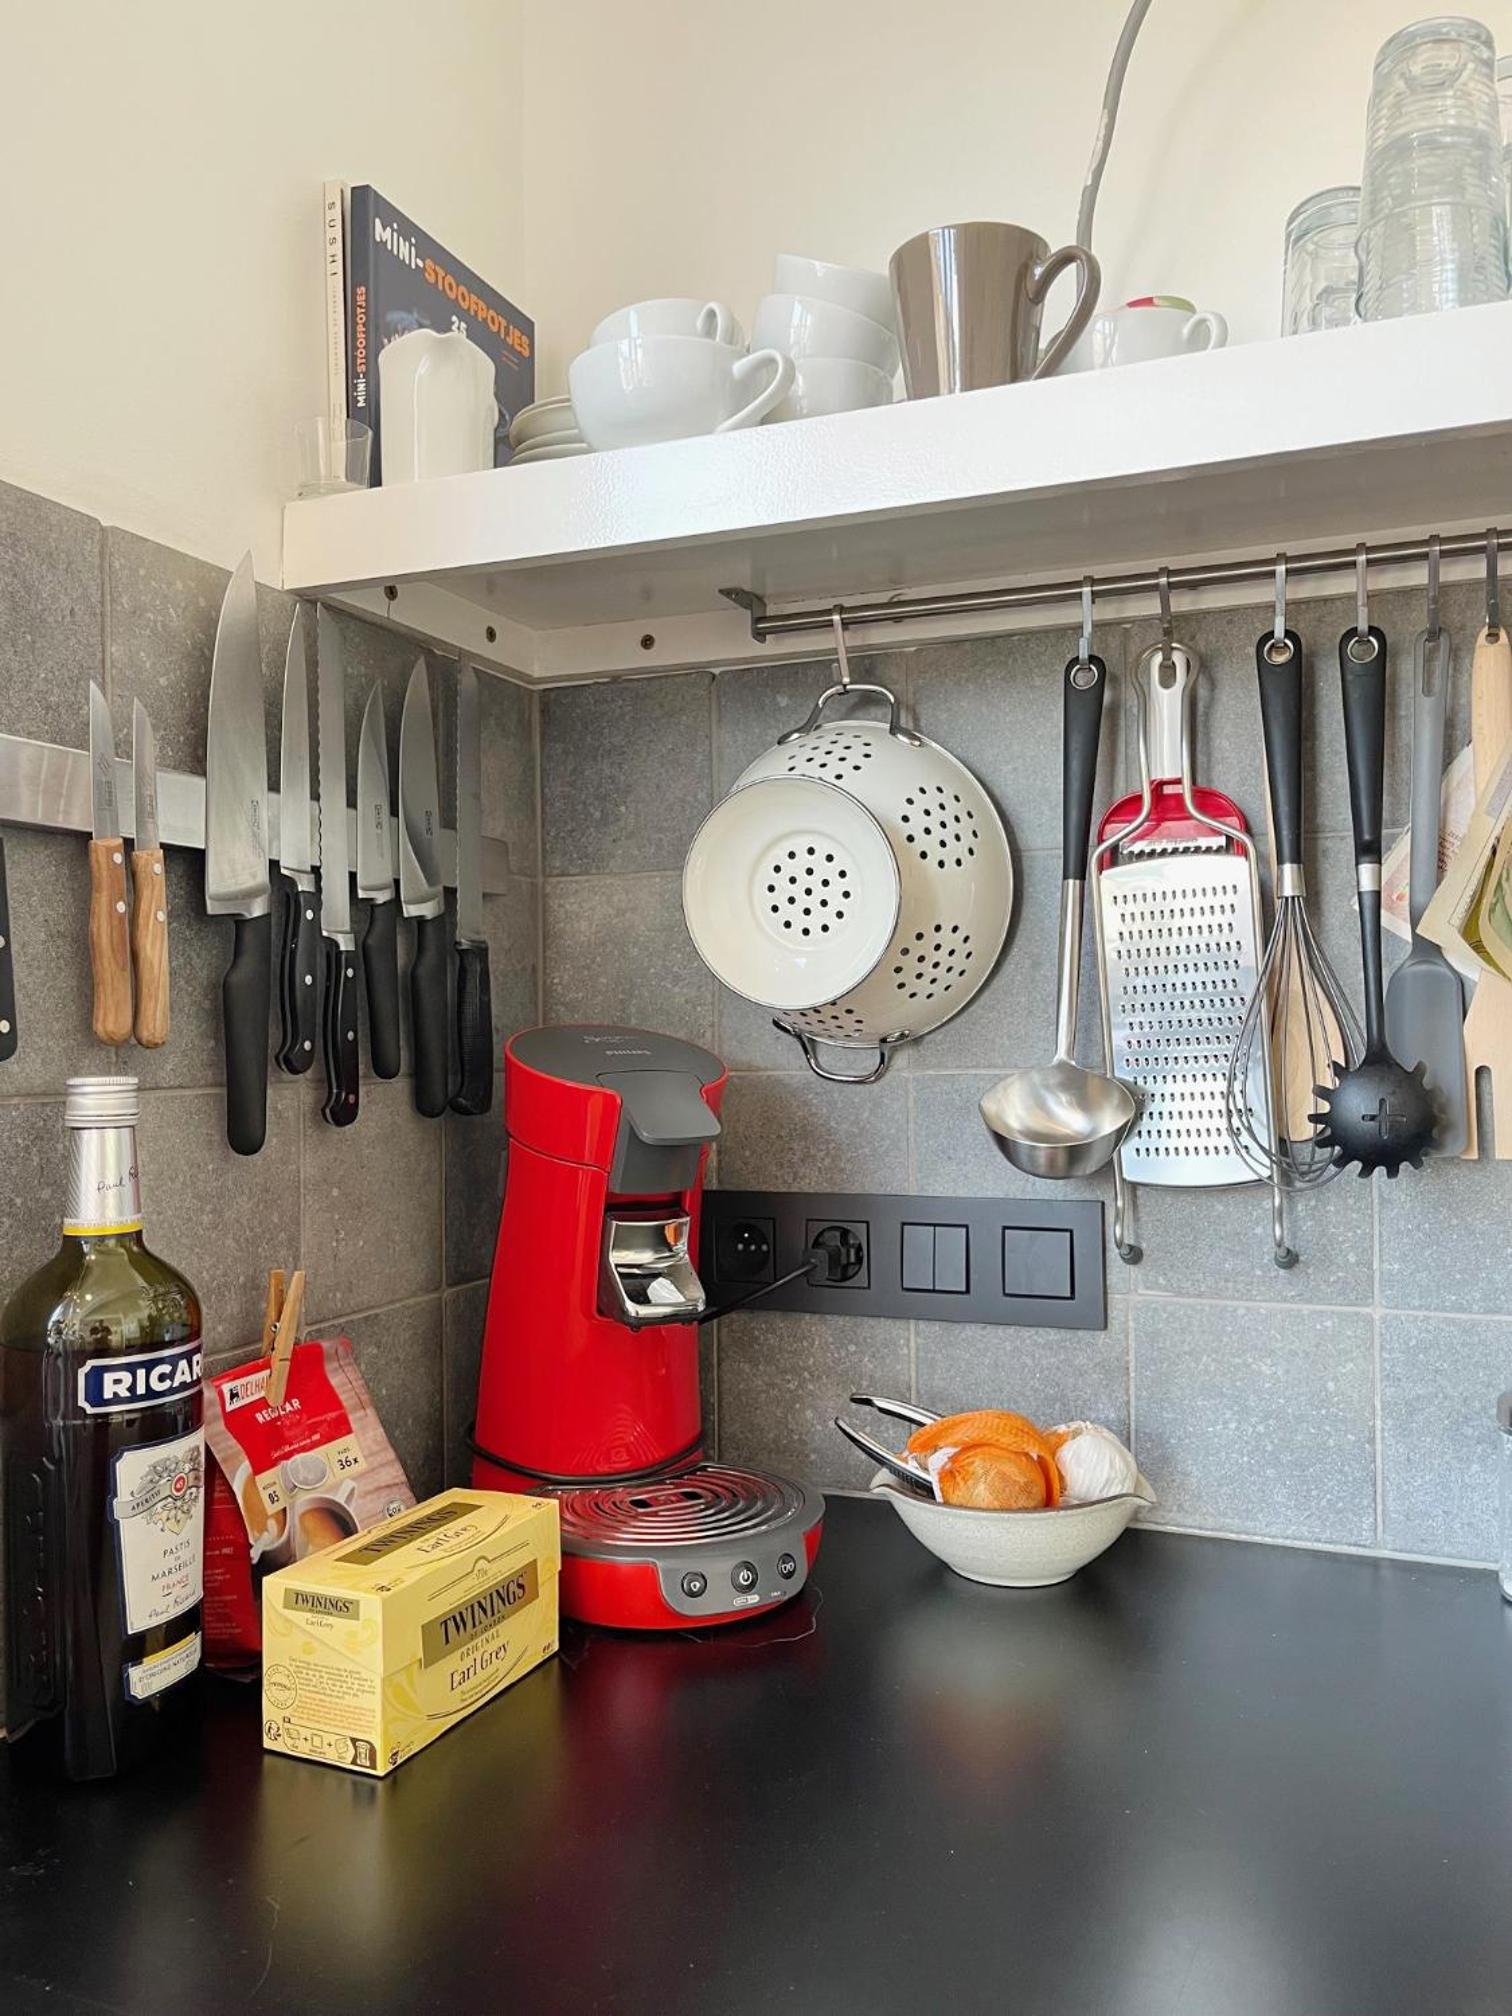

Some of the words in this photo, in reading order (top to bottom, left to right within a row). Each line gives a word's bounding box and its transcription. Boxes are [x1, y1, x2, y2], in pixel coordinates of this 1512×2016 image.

[327, 201, 338, 276] SUSHI
[337, 1456, 360, 1471] 36x
[151, 1553, 196, 1582] MARSEILLE
[294, 1591, 351, 1614] TWININGS
[440, 1576, 526, 1646] TWININGS
[450, 1657, 478, 1692] Earl
[480, 1639, 509, 1671] Grey
